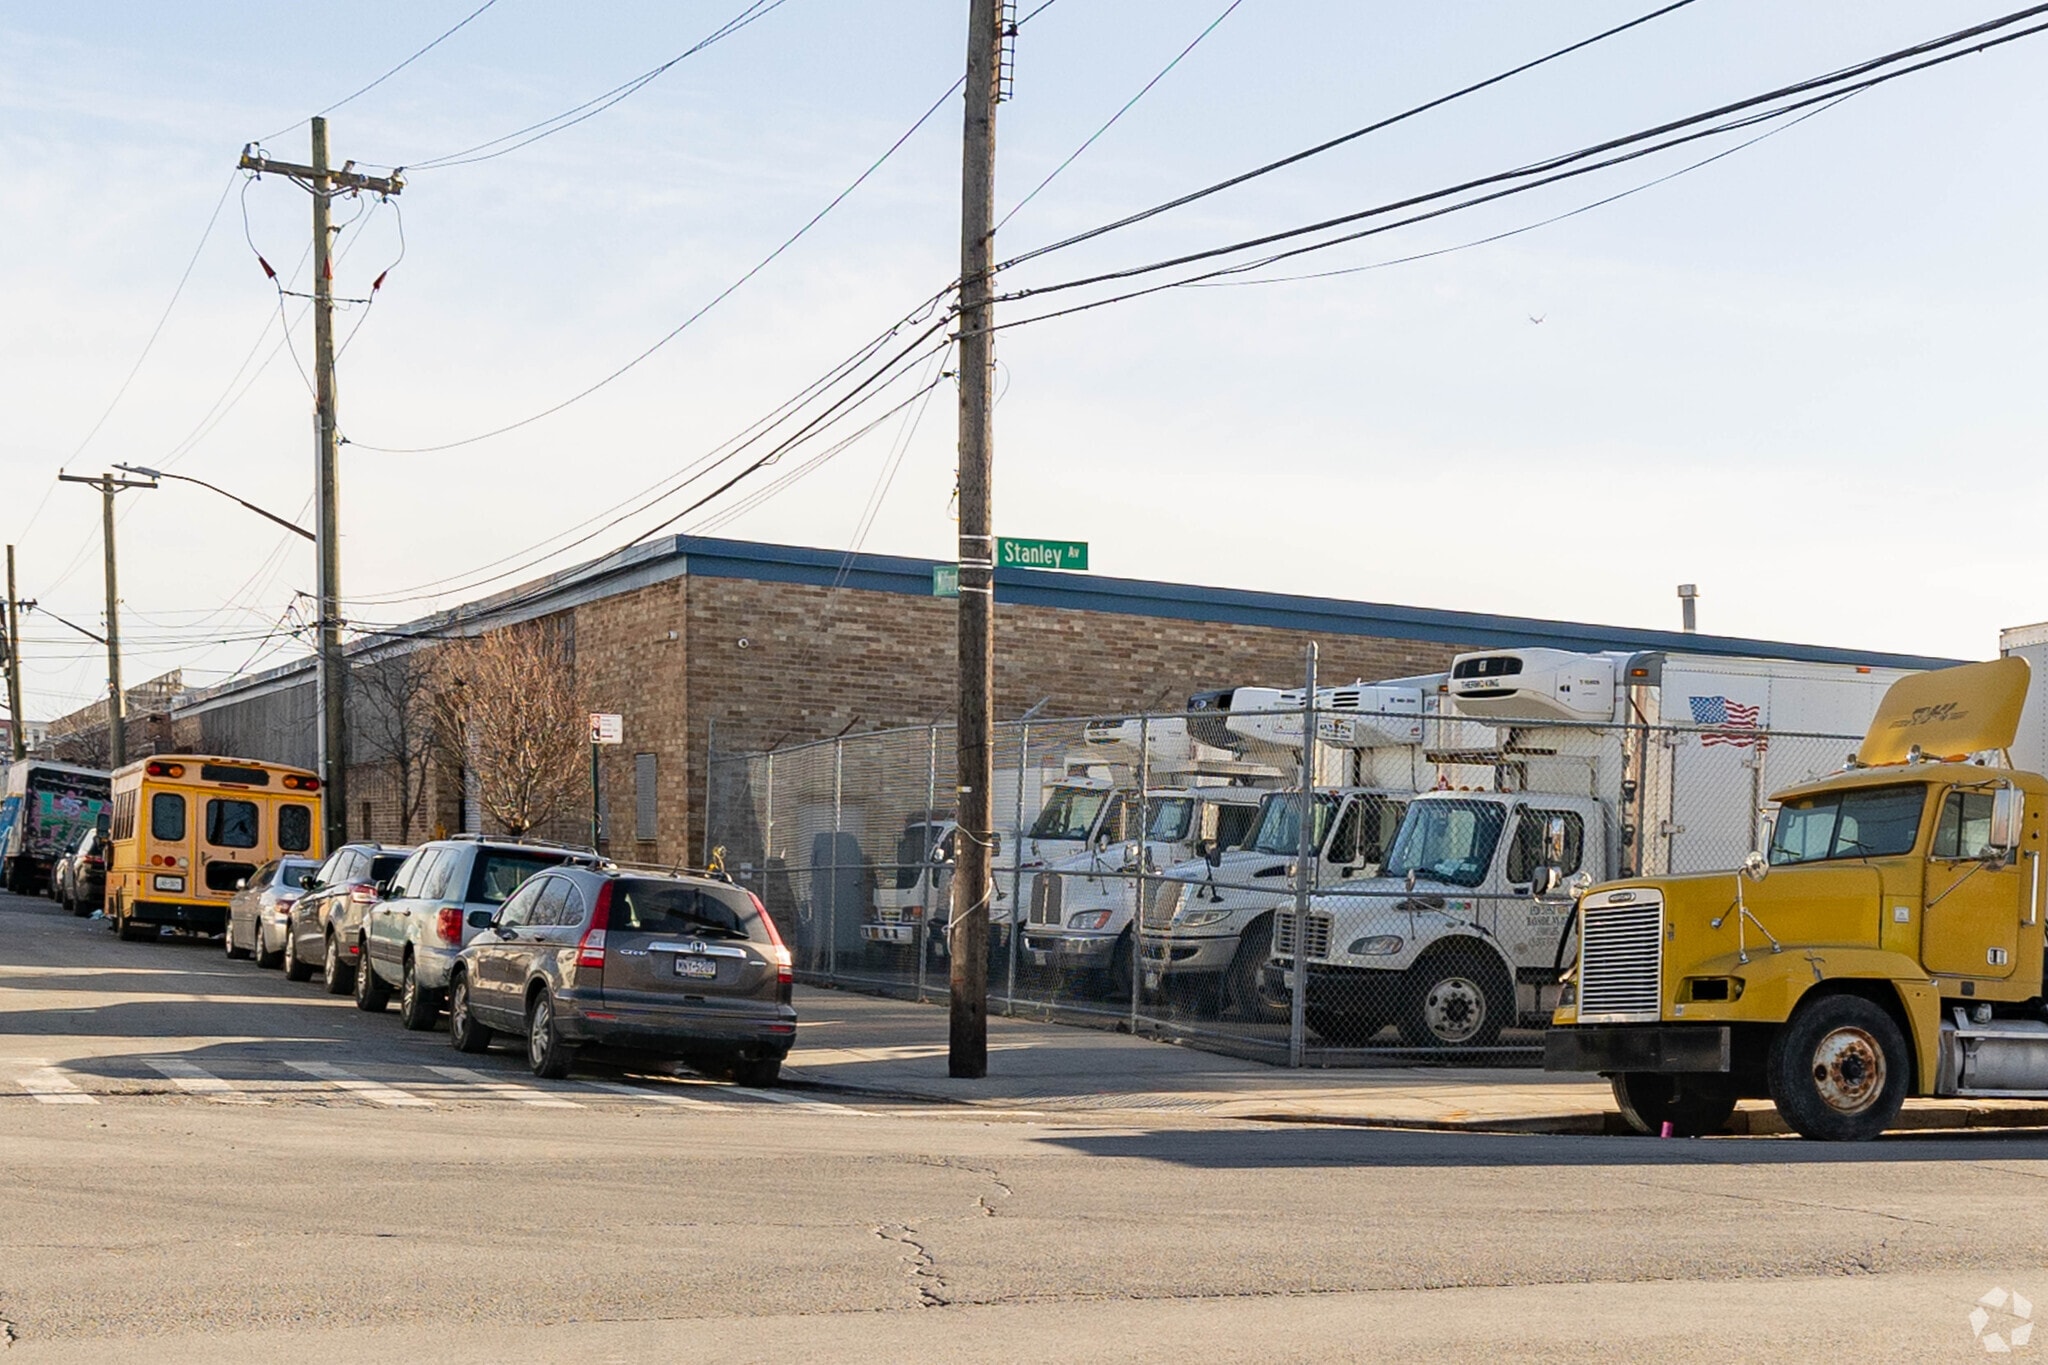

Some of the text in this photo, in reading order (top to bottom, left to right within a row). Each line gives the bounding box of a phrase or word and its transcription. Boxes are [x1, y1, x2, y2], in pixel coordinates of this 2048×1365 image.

[1004, 541, 1062, 568] Stanley
[1461, 677, 1500, 689] THERMO KING
[229, 851, 236, 860] 1
